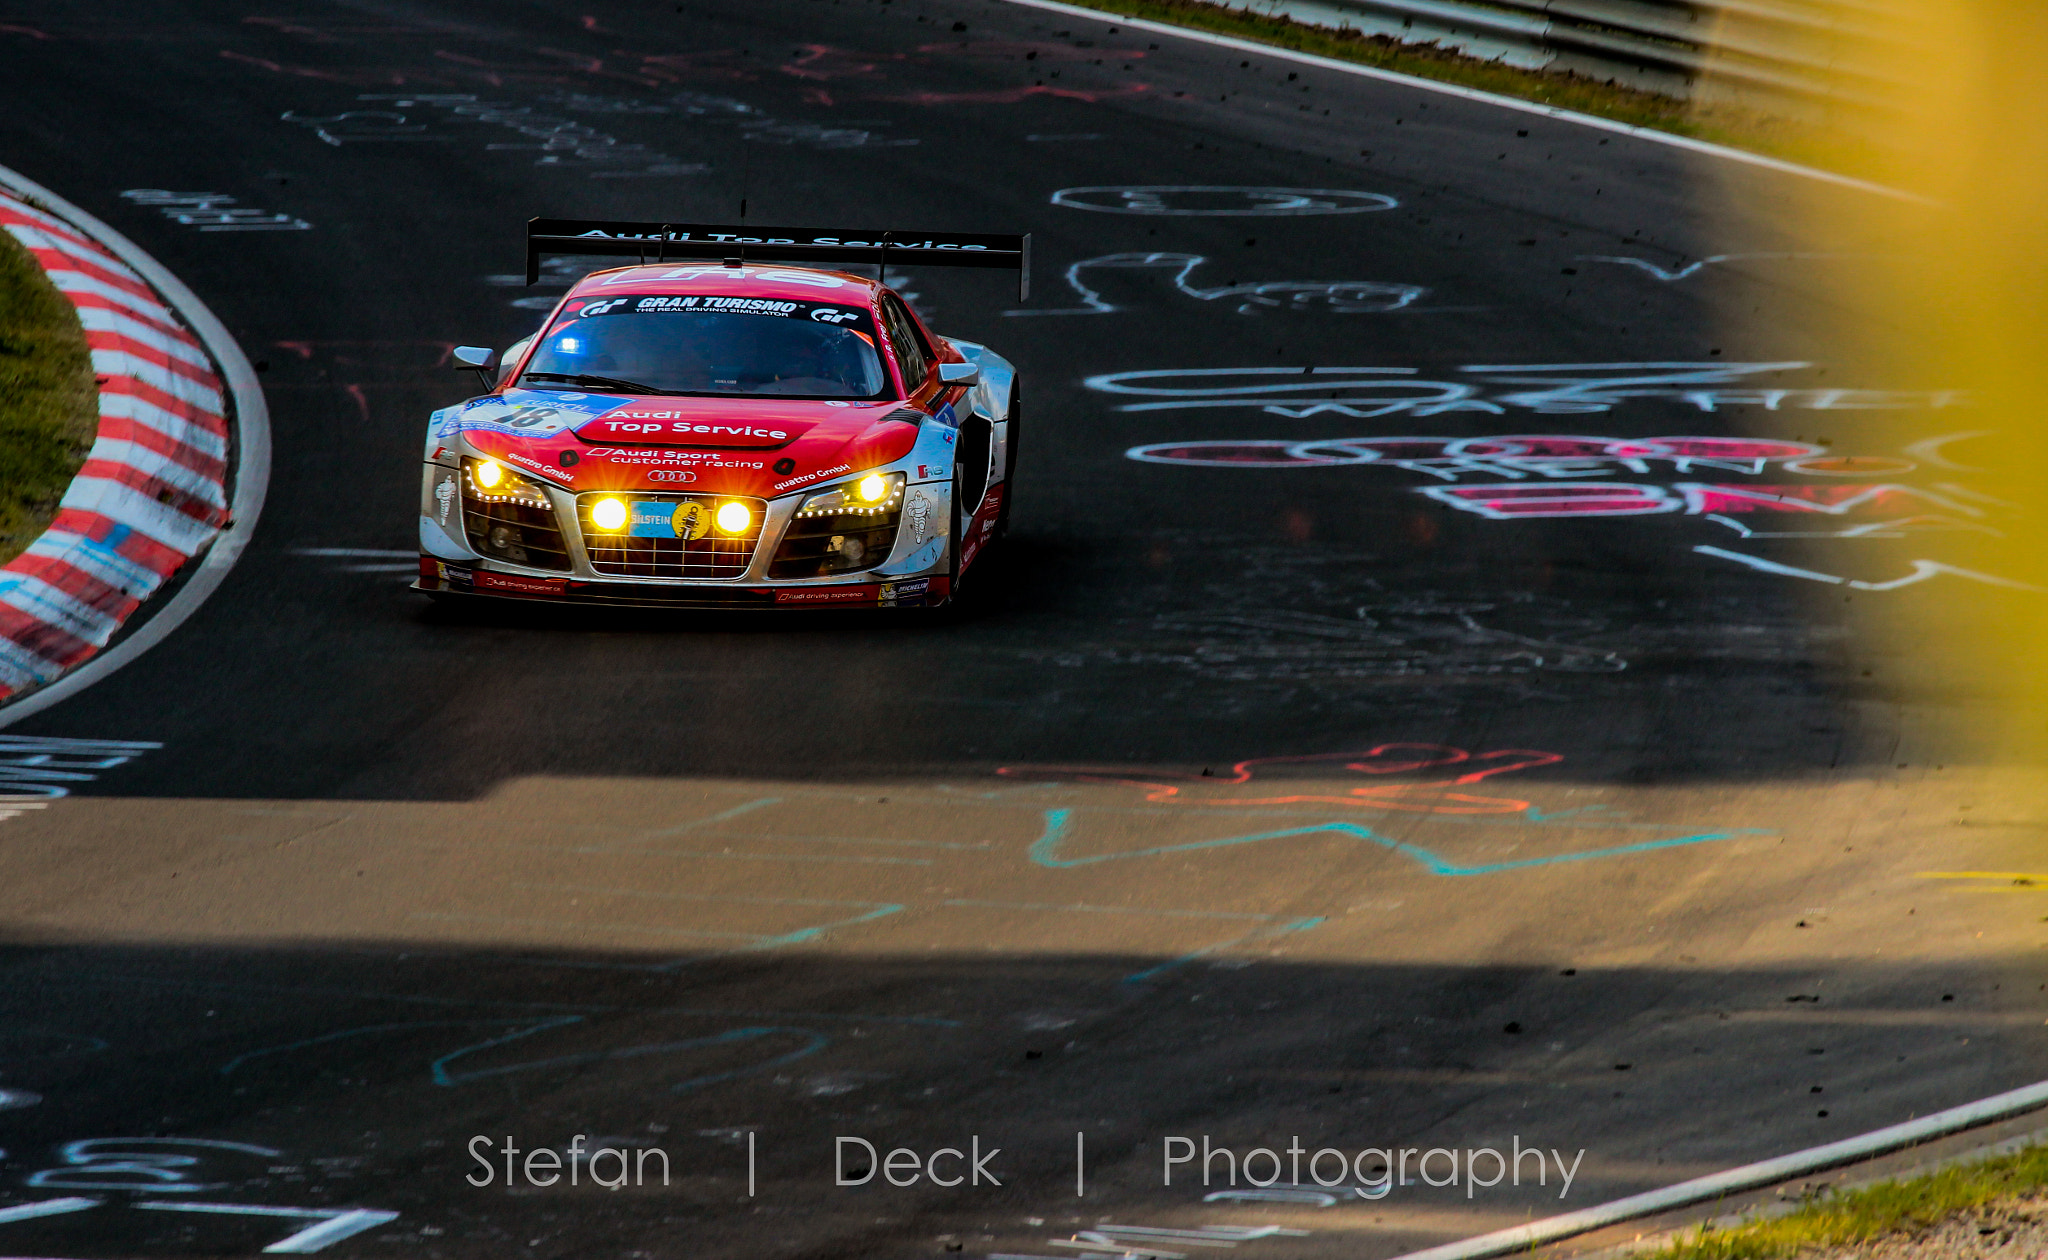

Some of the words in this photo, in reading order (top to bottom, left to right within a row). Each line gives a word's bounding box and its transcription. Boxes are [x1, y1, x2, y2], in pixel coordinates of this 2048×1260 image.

[577, 229, 691, 241] Audi
[708, 233, 796, 246] Top
[812, 237, 988, 251] Service
[637, 296, 700, 308] GRAN
[730, 308, 789, 317] SIMULATOR
[492, 407, 560, 428] 18
[606, 411, 682, 419] Audi
[605, 422, 663, 434] Top
[672, 422, 787, 439] Service
[611, 449, 659, 458] Audi
[663, 450, 721, 460] Sport
[508, 453, 543, 469] quattro
[542, 465, 575, 481] GmbH
[610, 457, 700, 466] customer
[705, 459, 764, 469] racing
[774, 474, 816, 490] quattro
[816, 463, 851, 477] GmbH
[631, 514, 671, 526] BILSTEIN
[898, 581, 930, 593] MICHELIN
[806, 592, 829, 601] driving
